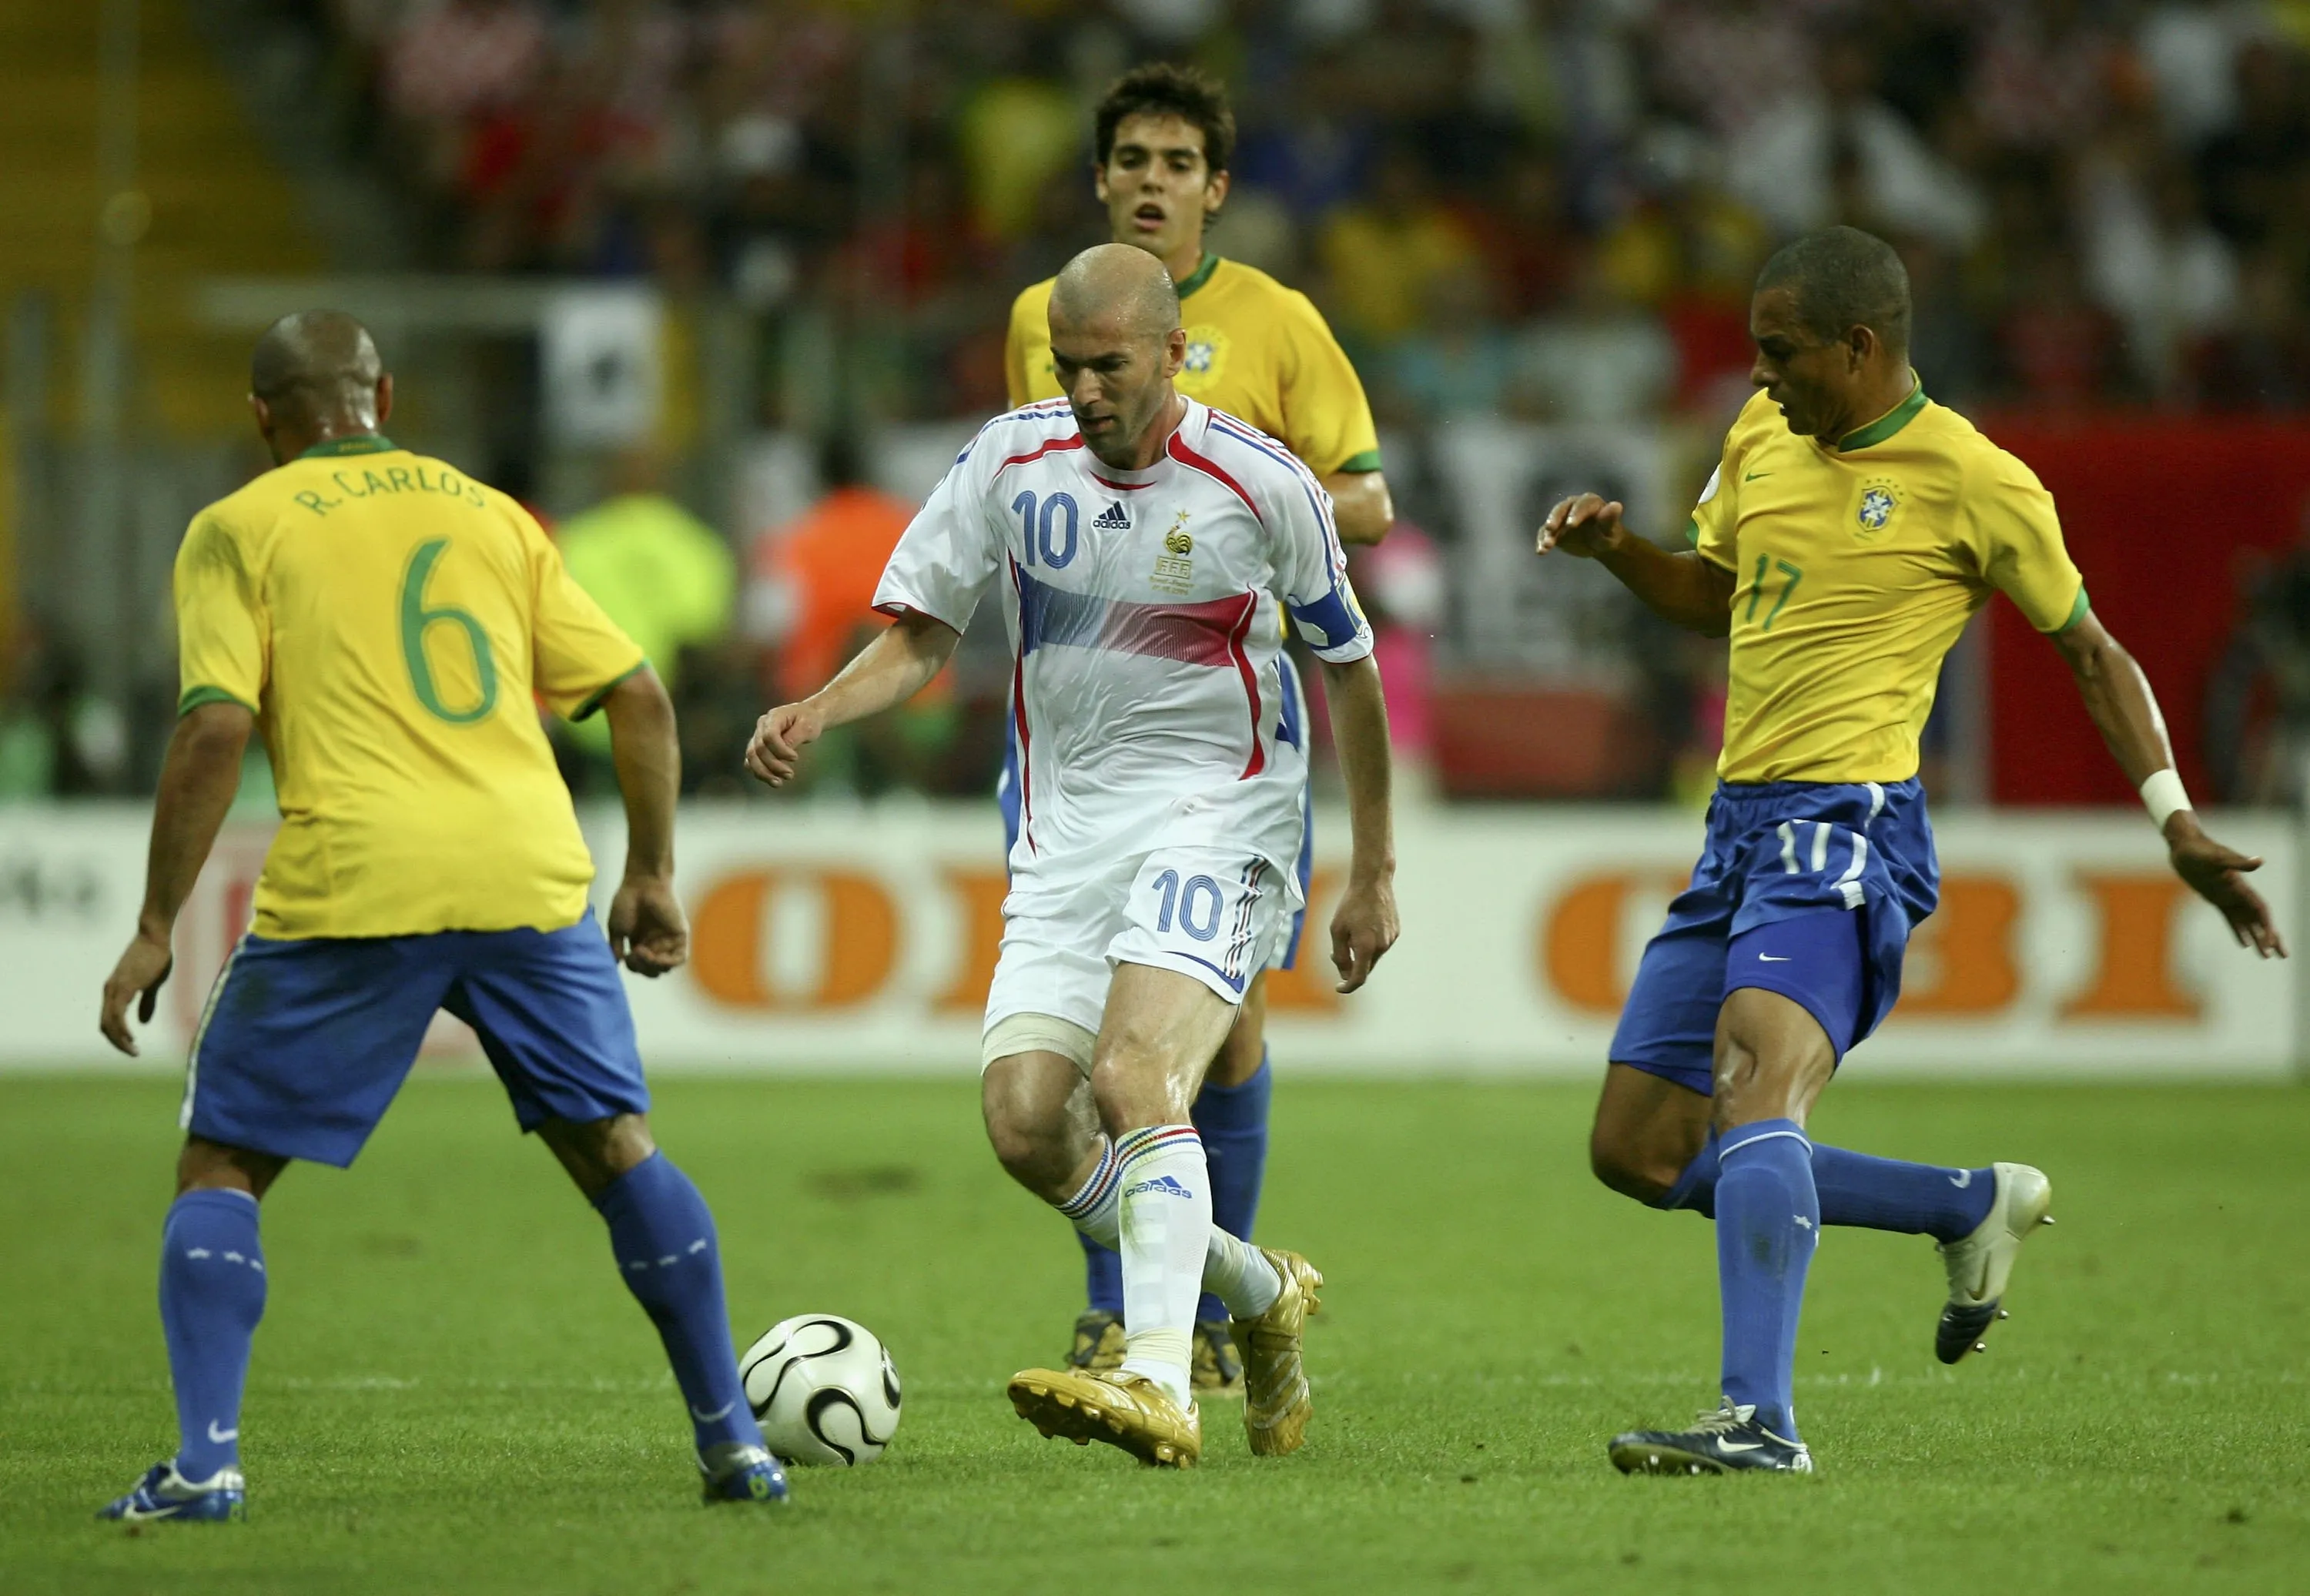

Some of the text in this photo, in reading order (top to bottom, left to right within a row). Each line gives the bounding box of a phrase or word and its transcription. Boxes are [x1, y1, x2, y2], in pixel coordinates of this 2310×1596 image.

[1012, 490, 1078, 569] 10
[1093, 519, 1131, 530] adidas
[1746, 553, 1803, 632] 17
[400, 538, 497, 724] 6
[1152, 869, 1224, 942] 10
[1125, 1180, 1192, 1199] adidas
